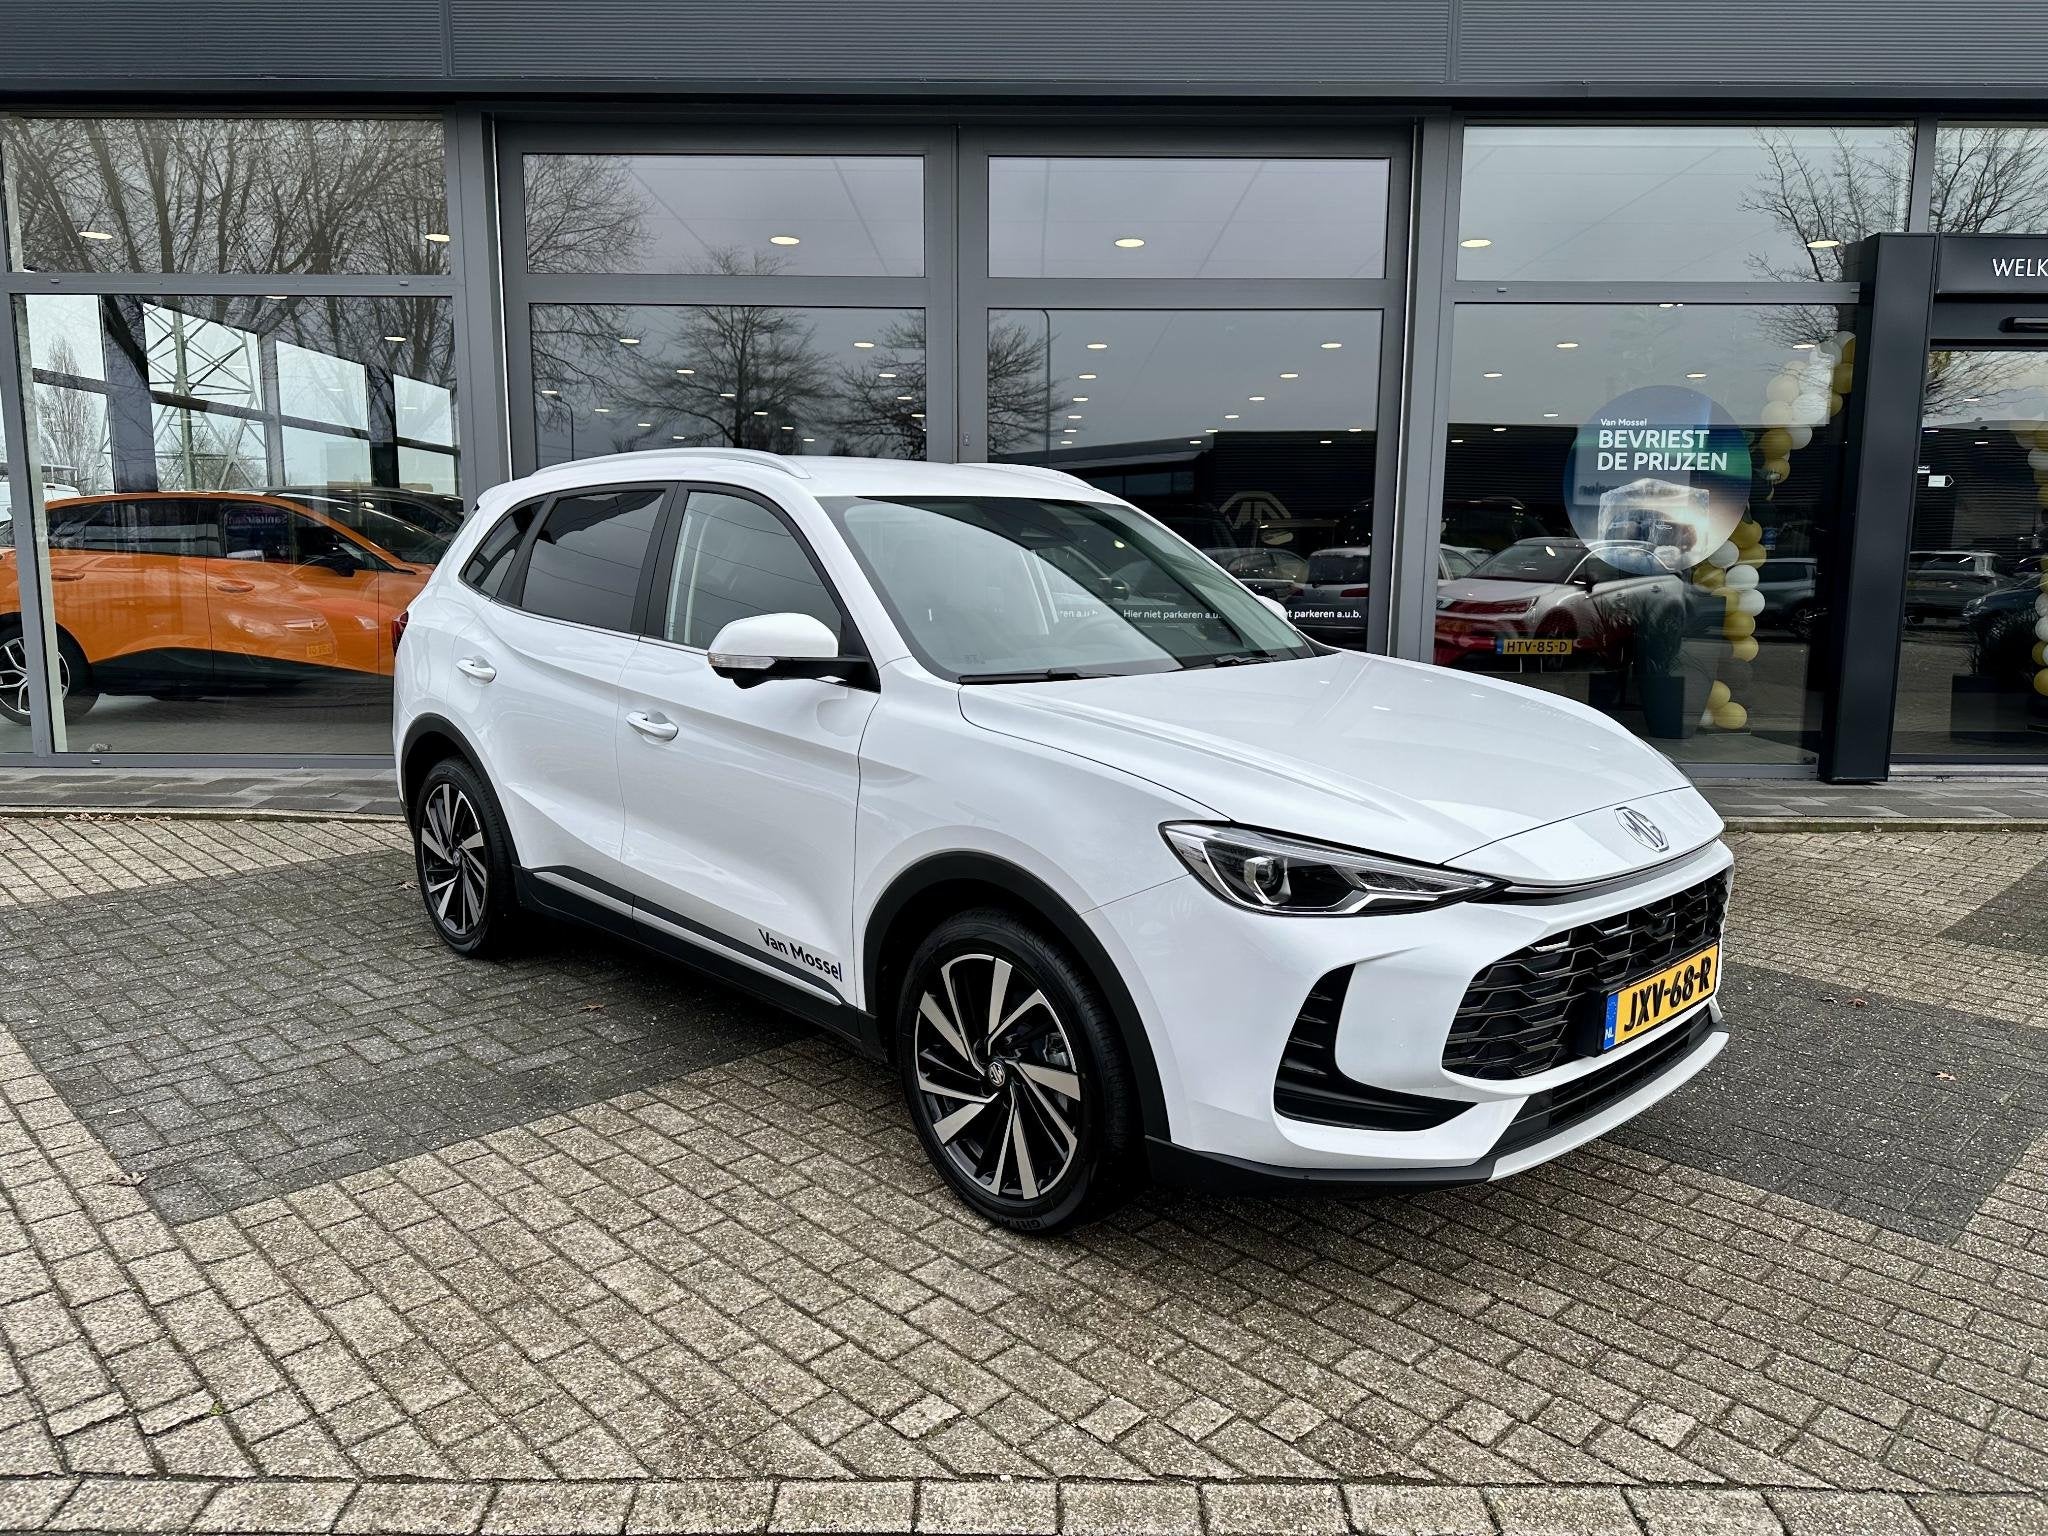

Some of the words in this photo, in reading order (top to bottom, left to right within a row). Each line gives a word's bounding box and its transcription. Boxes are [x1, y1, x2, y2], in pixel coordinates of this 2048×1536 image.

[1992, 258, 2048, 277] WELK
[1600, 418, 1616, 427] Van
[1618, 417, 1648, 427] Mossel
[1598, 429, 1710, 449] BEVRIEST
[1597, 452, 1628, 471] DE
[1633, 452, 1728, 471] PRIJZEN
[1123, 609, 1141, 618] Hier
[1143, 609, 1161, 618] niet
[1163, 610, 1203, 620] parkeren
[1294, 609, 1335, 620] parkeren
[1336, 609, 1362, 618] a.u.b.
[1506, 641, 1568, 653] HTV-85-D
[758, 927, 788, 956] Van
[789, 941, 843, 982] Mossel
[1623, 956, 1712, 1032] JXV-68-R
[1604, 1026, 1614, 1040] NL
